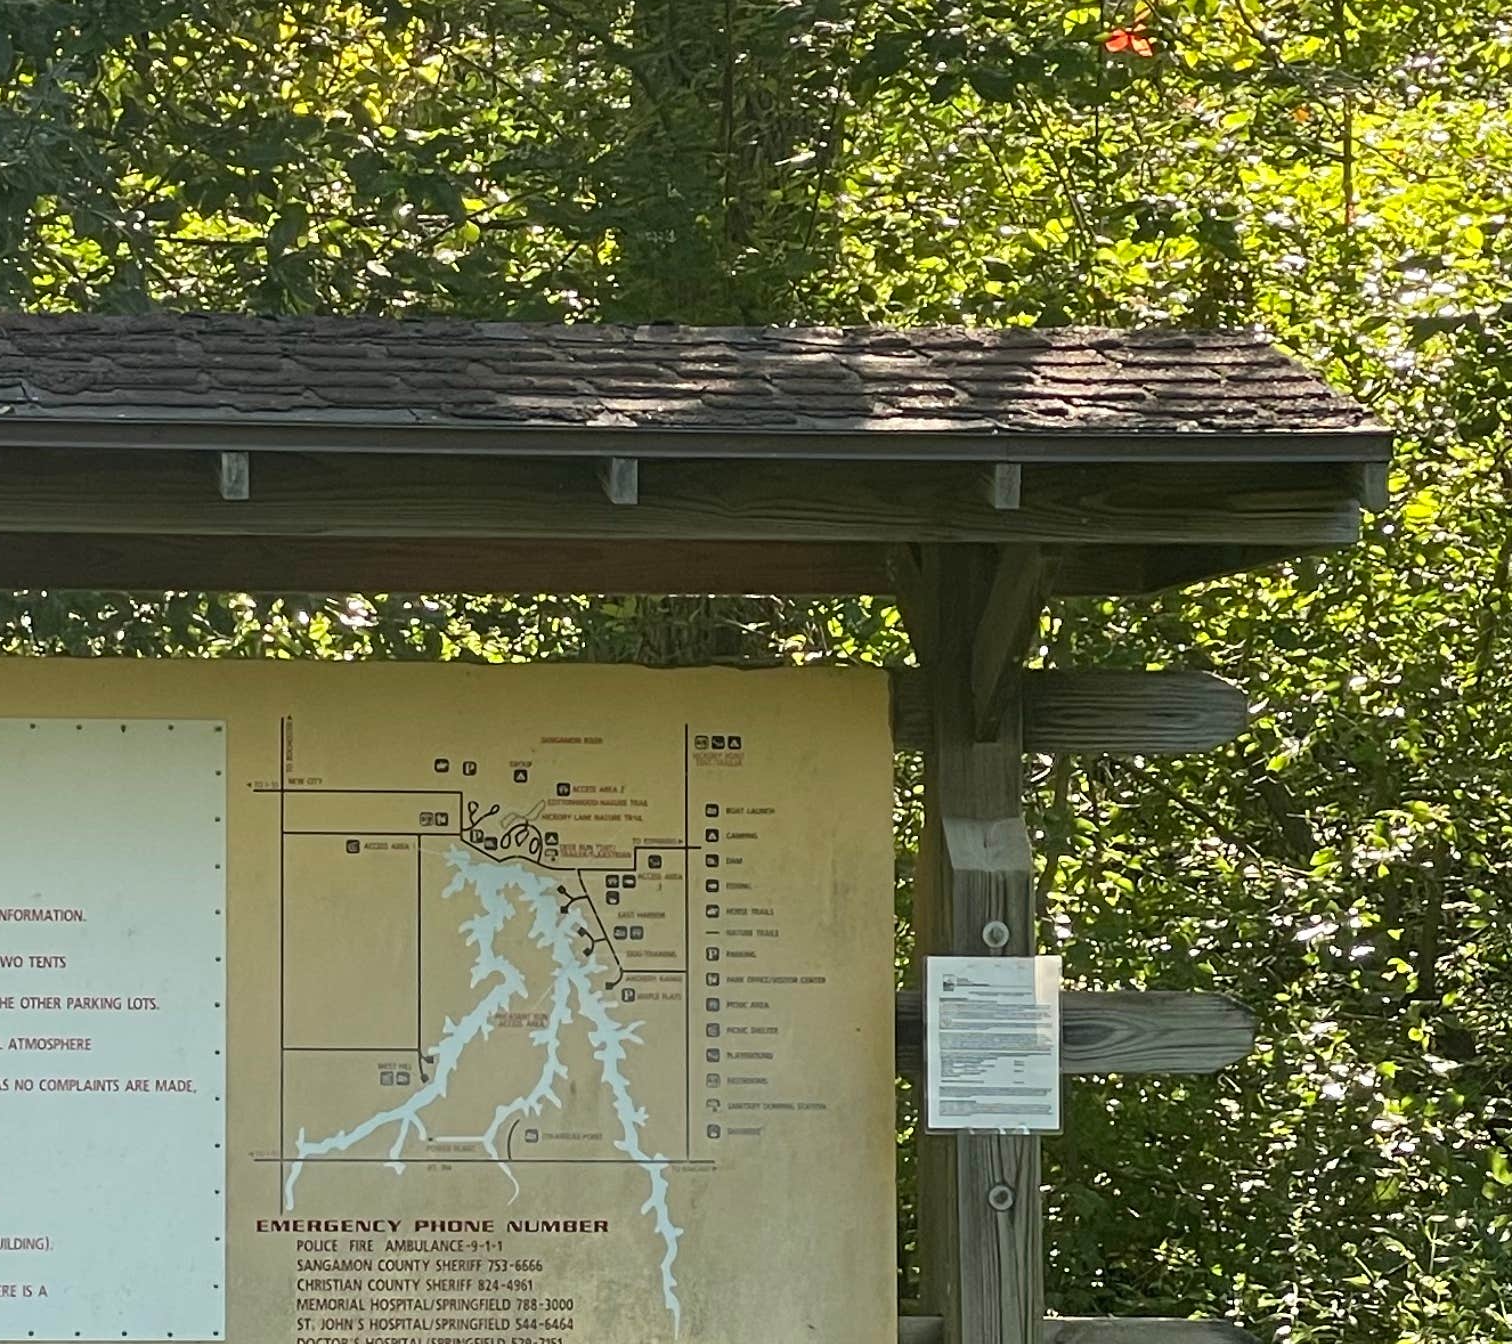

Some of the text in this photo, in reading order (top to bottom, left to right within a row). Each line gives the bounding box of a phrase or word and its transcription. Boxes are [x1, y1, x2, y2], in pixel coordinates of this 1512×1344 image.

[20, 997, 61, 1009] OTHER
[67, 997, 121, 1010] PARKING
[256, 1219, 610, 1234] EMERGENCY PHONE NUMBER
[297, 1240, 338, 1253] POLICE
[350, 1240, 374, 1253] FIRE
[297, 1258, 372, 1271] SANGAMON
[378, 1259, 430, 1272] COUNTY
[436, 1259, 482, 1272] SHERIFF
[297, 1278, 362, 1291] CHRISTIAN
[368, 1278, 421, 1291] COUNTY
[426, 1279, 472, 1291] SHERIFF
[296, 1298, 365, 1312] MEMORIAL
[370, 1298, 511, 1312] HOSPITAL/SPRINGFIELD
[369, 1317, 510, 1330] HOSPITAL/SPRINGFIELD
